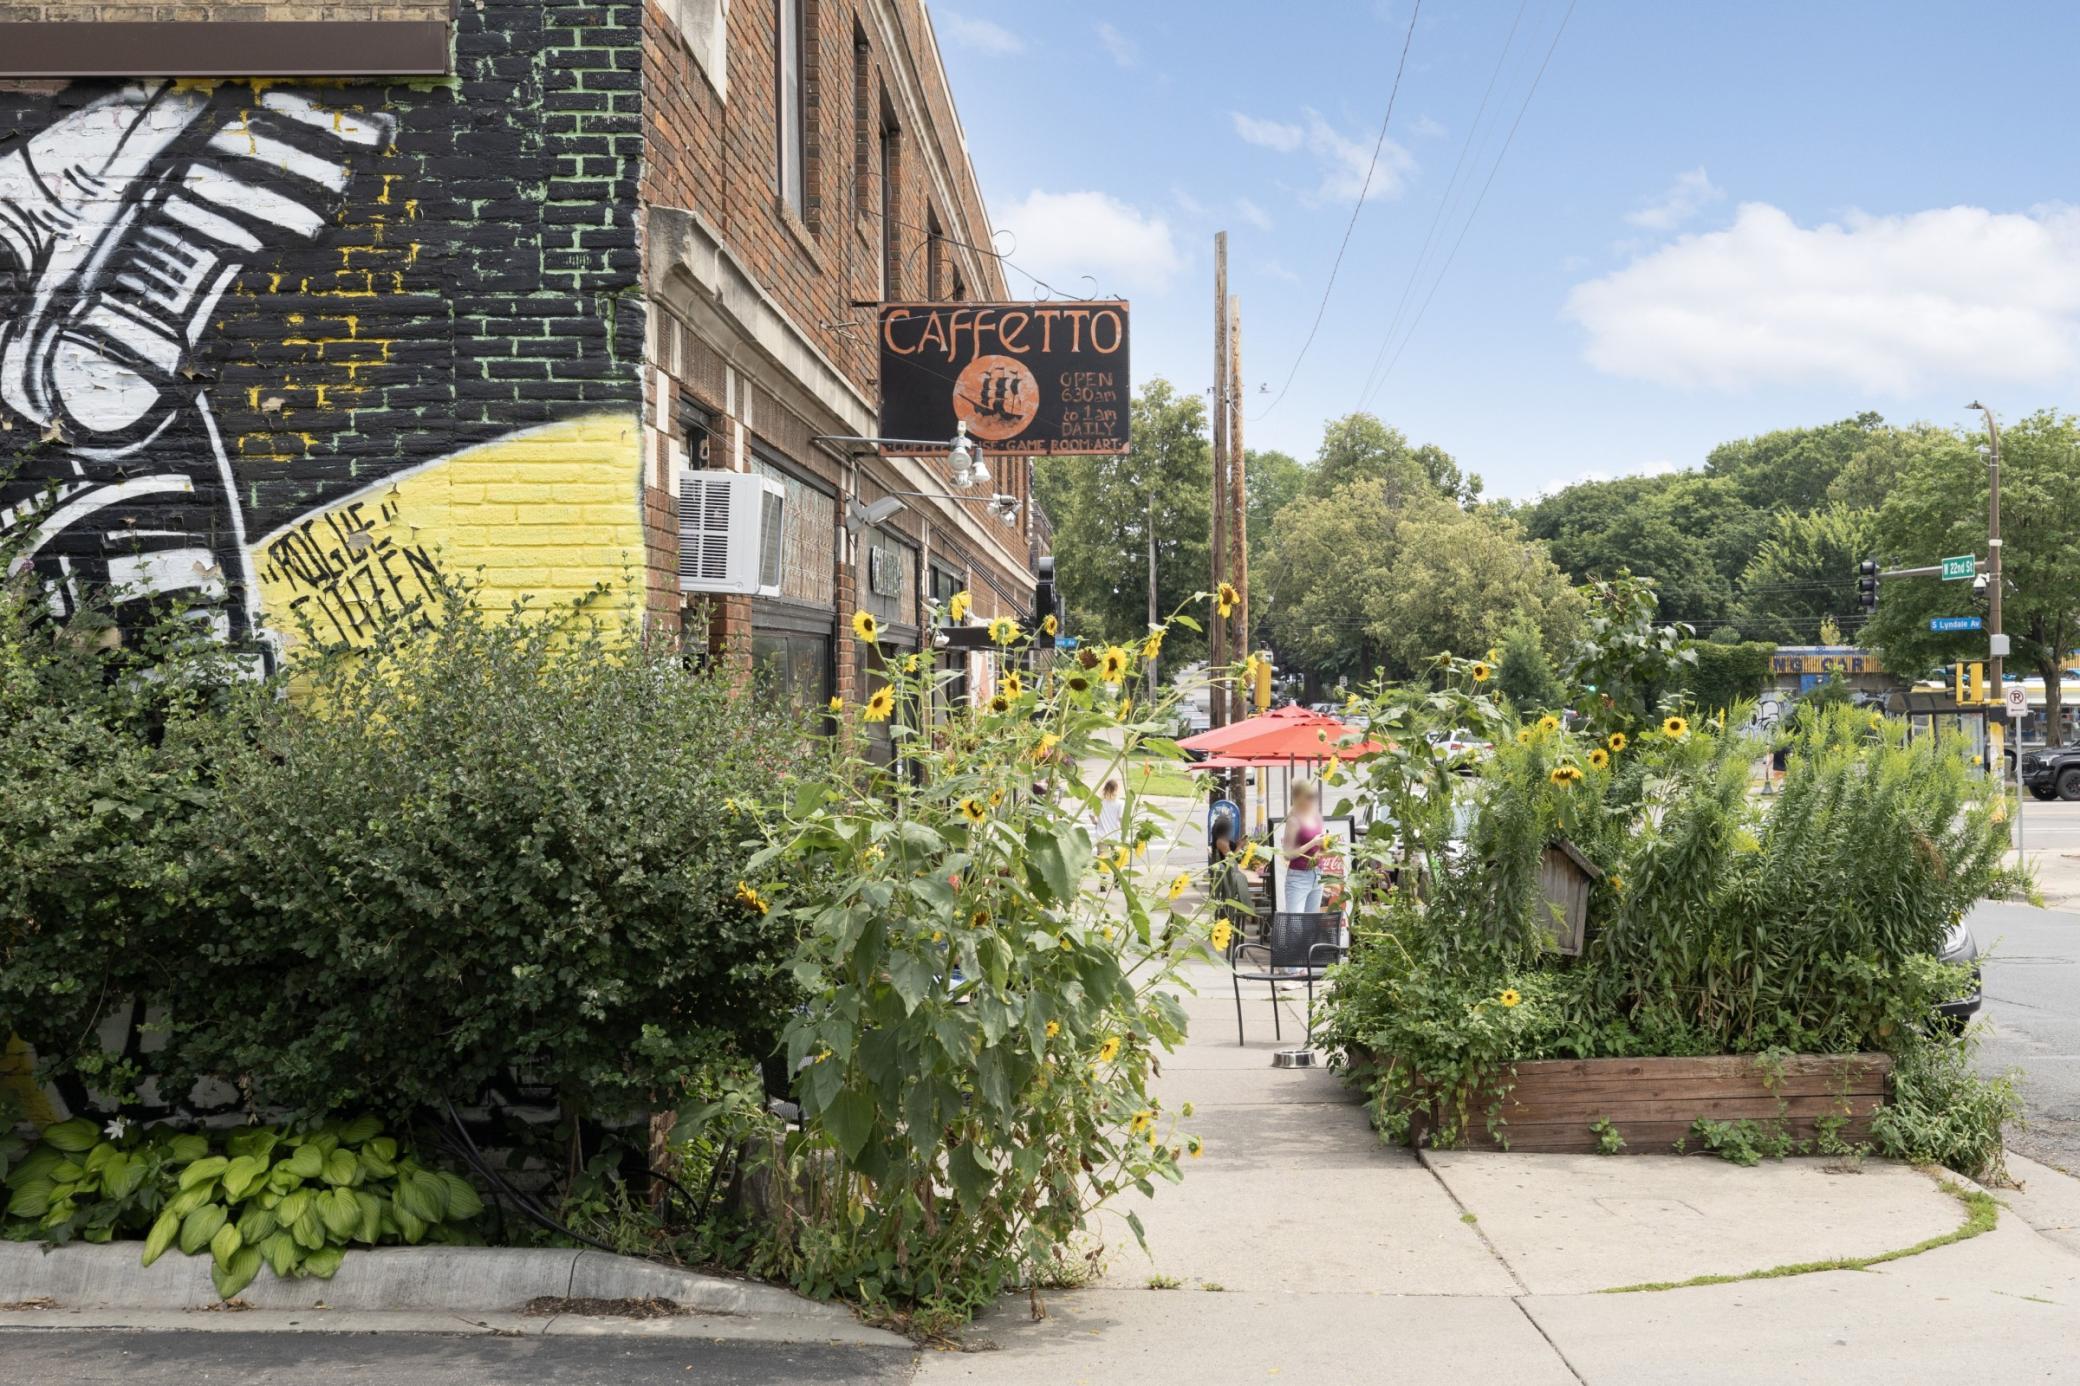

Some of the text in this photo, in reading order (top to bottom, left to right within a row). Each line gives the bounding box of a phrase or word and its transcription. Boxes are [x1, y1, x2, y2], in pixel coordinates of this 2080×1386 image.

[1060, 372, 1113, 387] OPEN
[1063, 406, 1079, 421] to
[1062, 422, 1115, 436] DAILY
[1006, 439, 1045, 450] GAME
[1943, 560, 1973, 575] W 22nd St
[1939, 620, 1968, 630] Lyndale
[1970, 619, 1980, 628] Av
